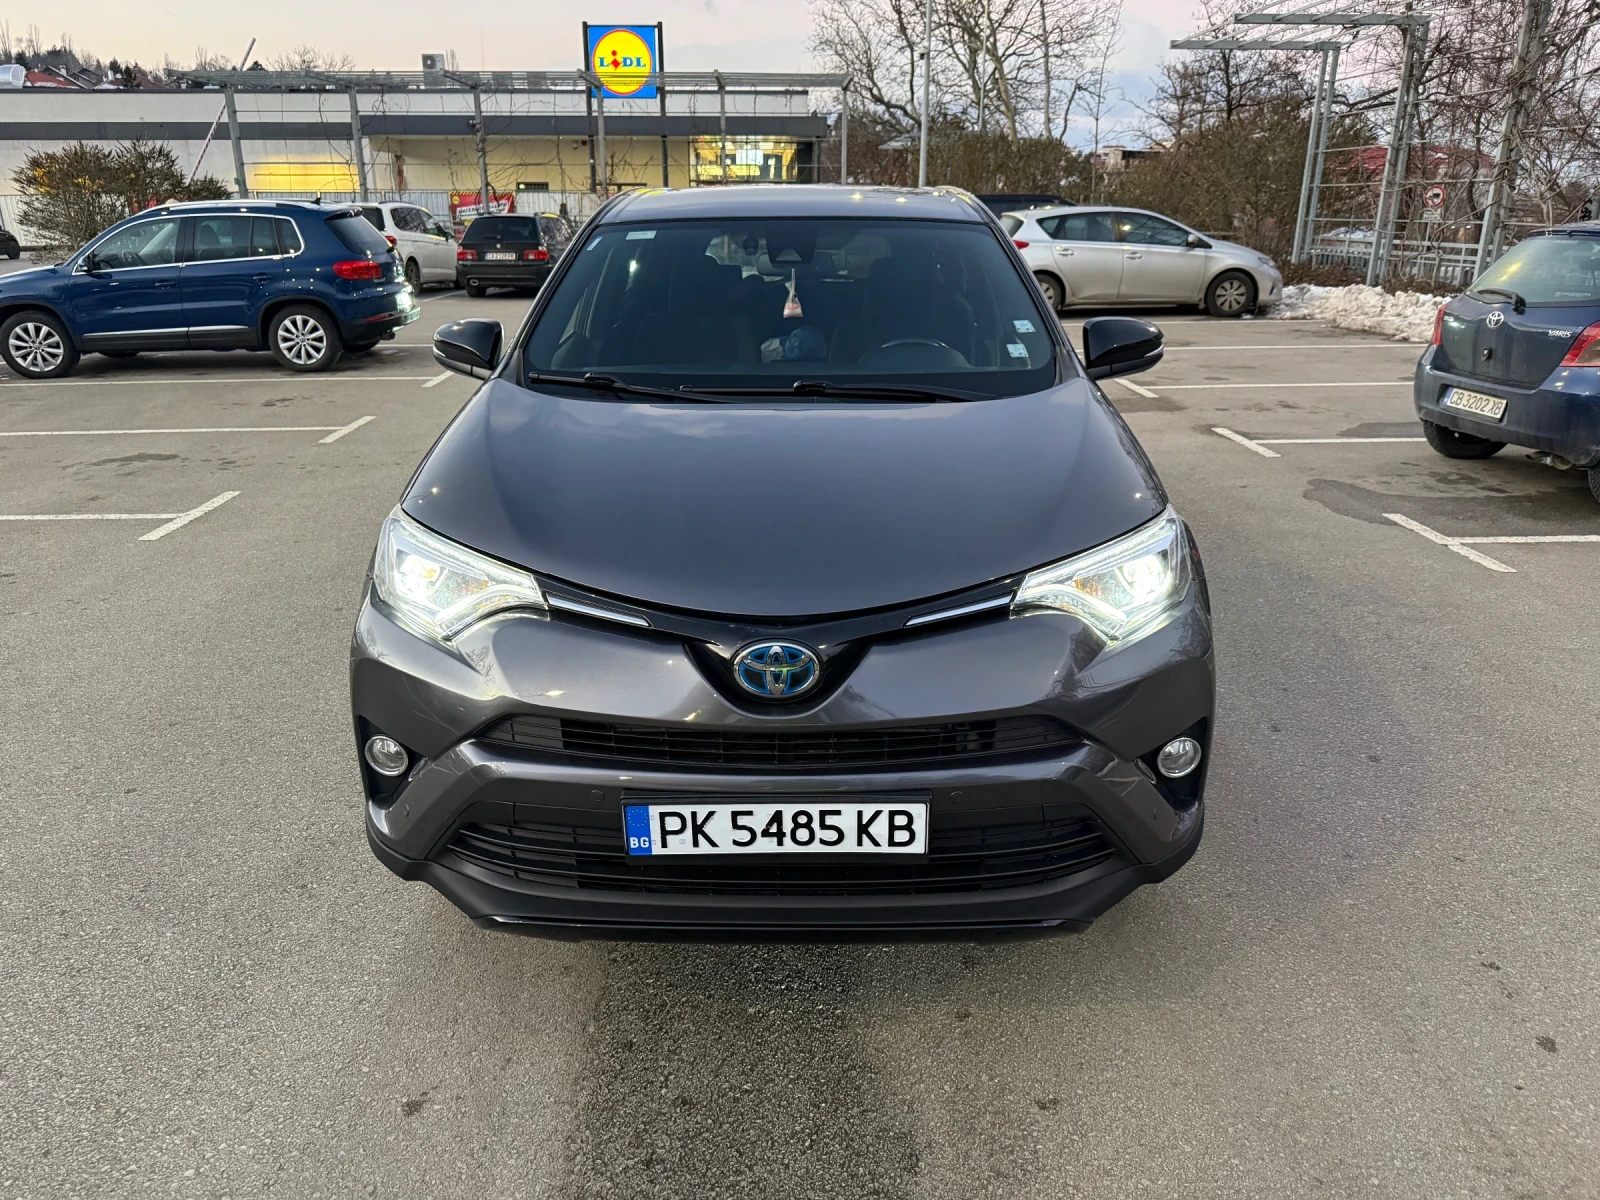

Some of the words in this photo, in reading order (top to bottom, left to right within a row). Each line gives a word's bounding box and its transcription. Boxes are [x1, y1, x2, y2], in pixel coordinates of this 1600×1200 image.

[1548, 329, 1572, 338] YARIS
[1450, 391, 1465, 406] CB
[1462, 394, 1490, 412] 3202
[658, 810, 720, 849] PK
[730, 809, 845, 848] 5485
[856, 809, 916, 848] KB
[630, 836, 650, 849] BG
